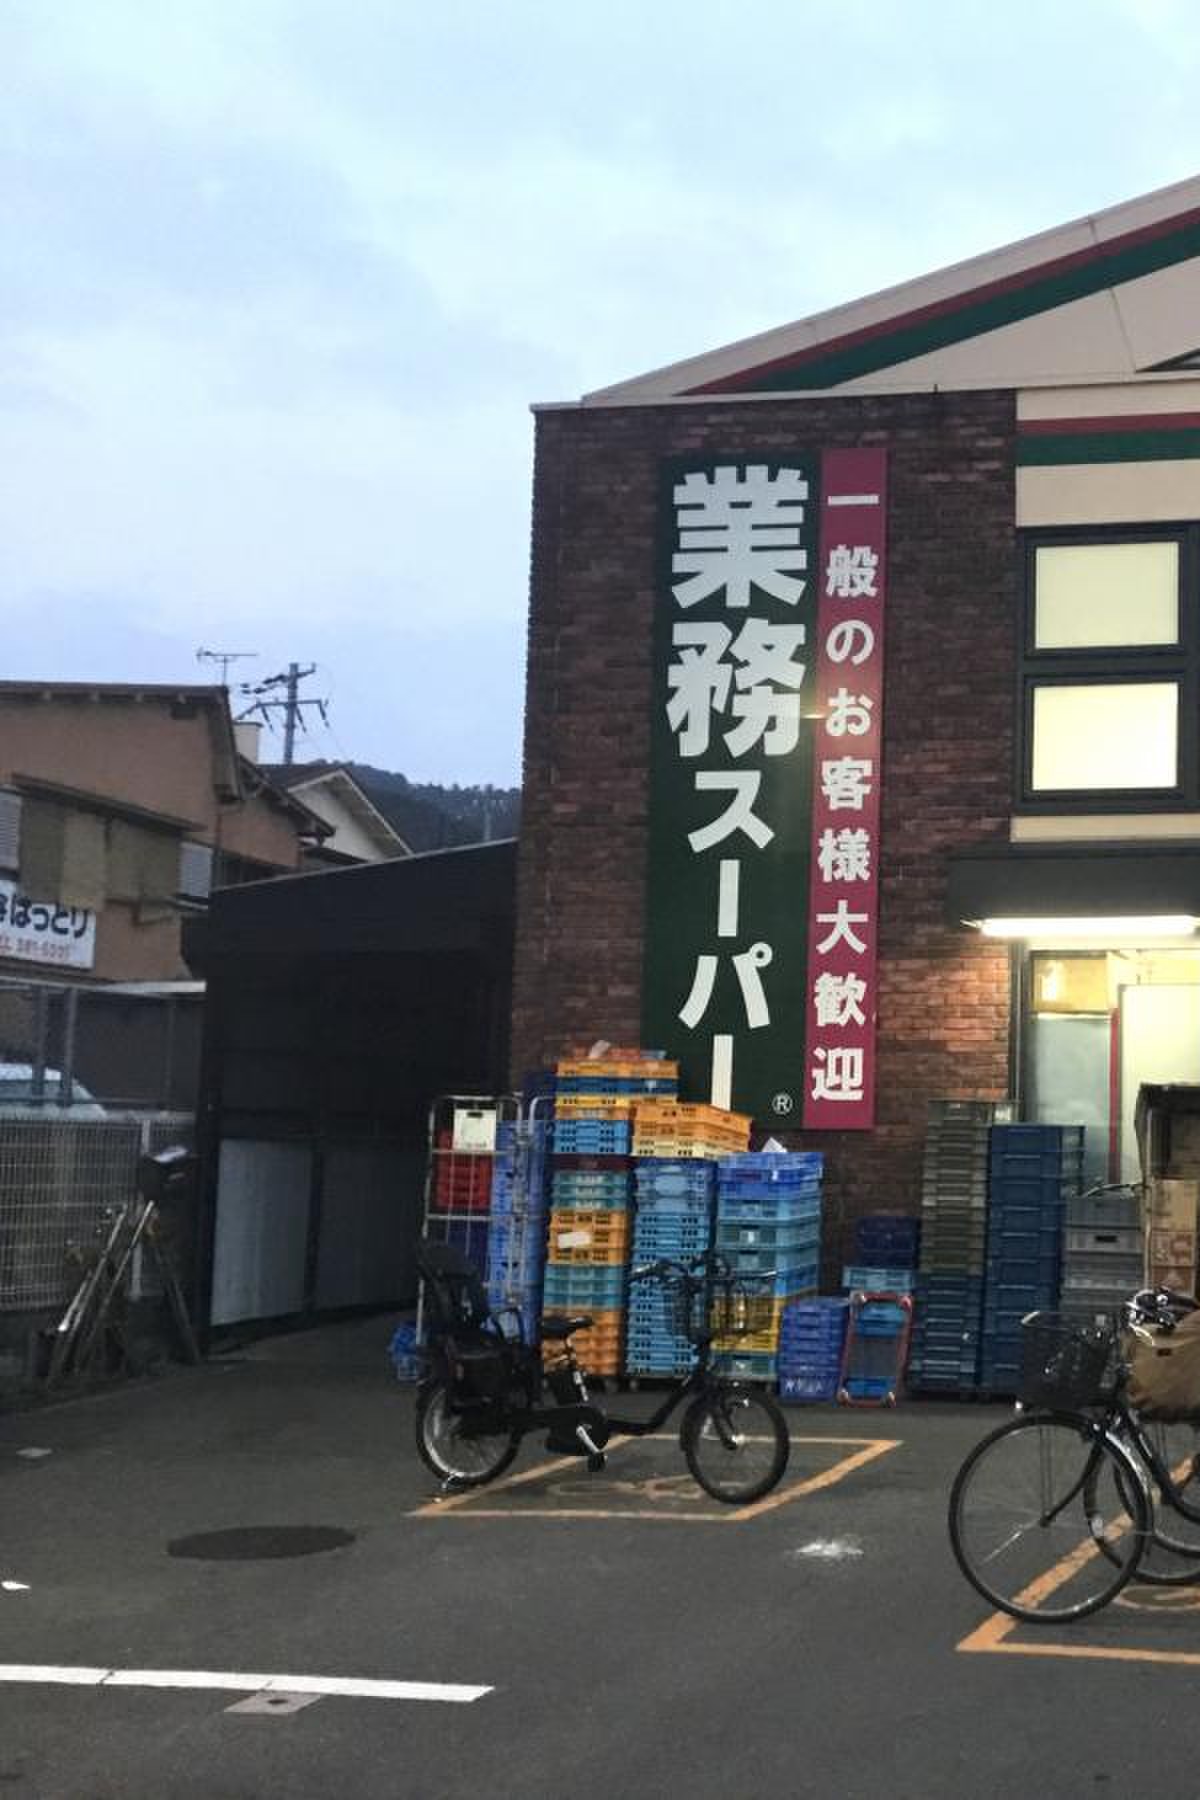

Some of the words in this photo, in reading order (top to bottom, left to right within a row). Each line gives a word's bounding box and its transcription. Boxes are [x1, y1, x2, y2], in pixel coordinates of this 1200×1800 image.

[666, 464, 808, 1111] 業務スーパー
[811, 494, 880, 1102] 一般のお客様大歓迎
